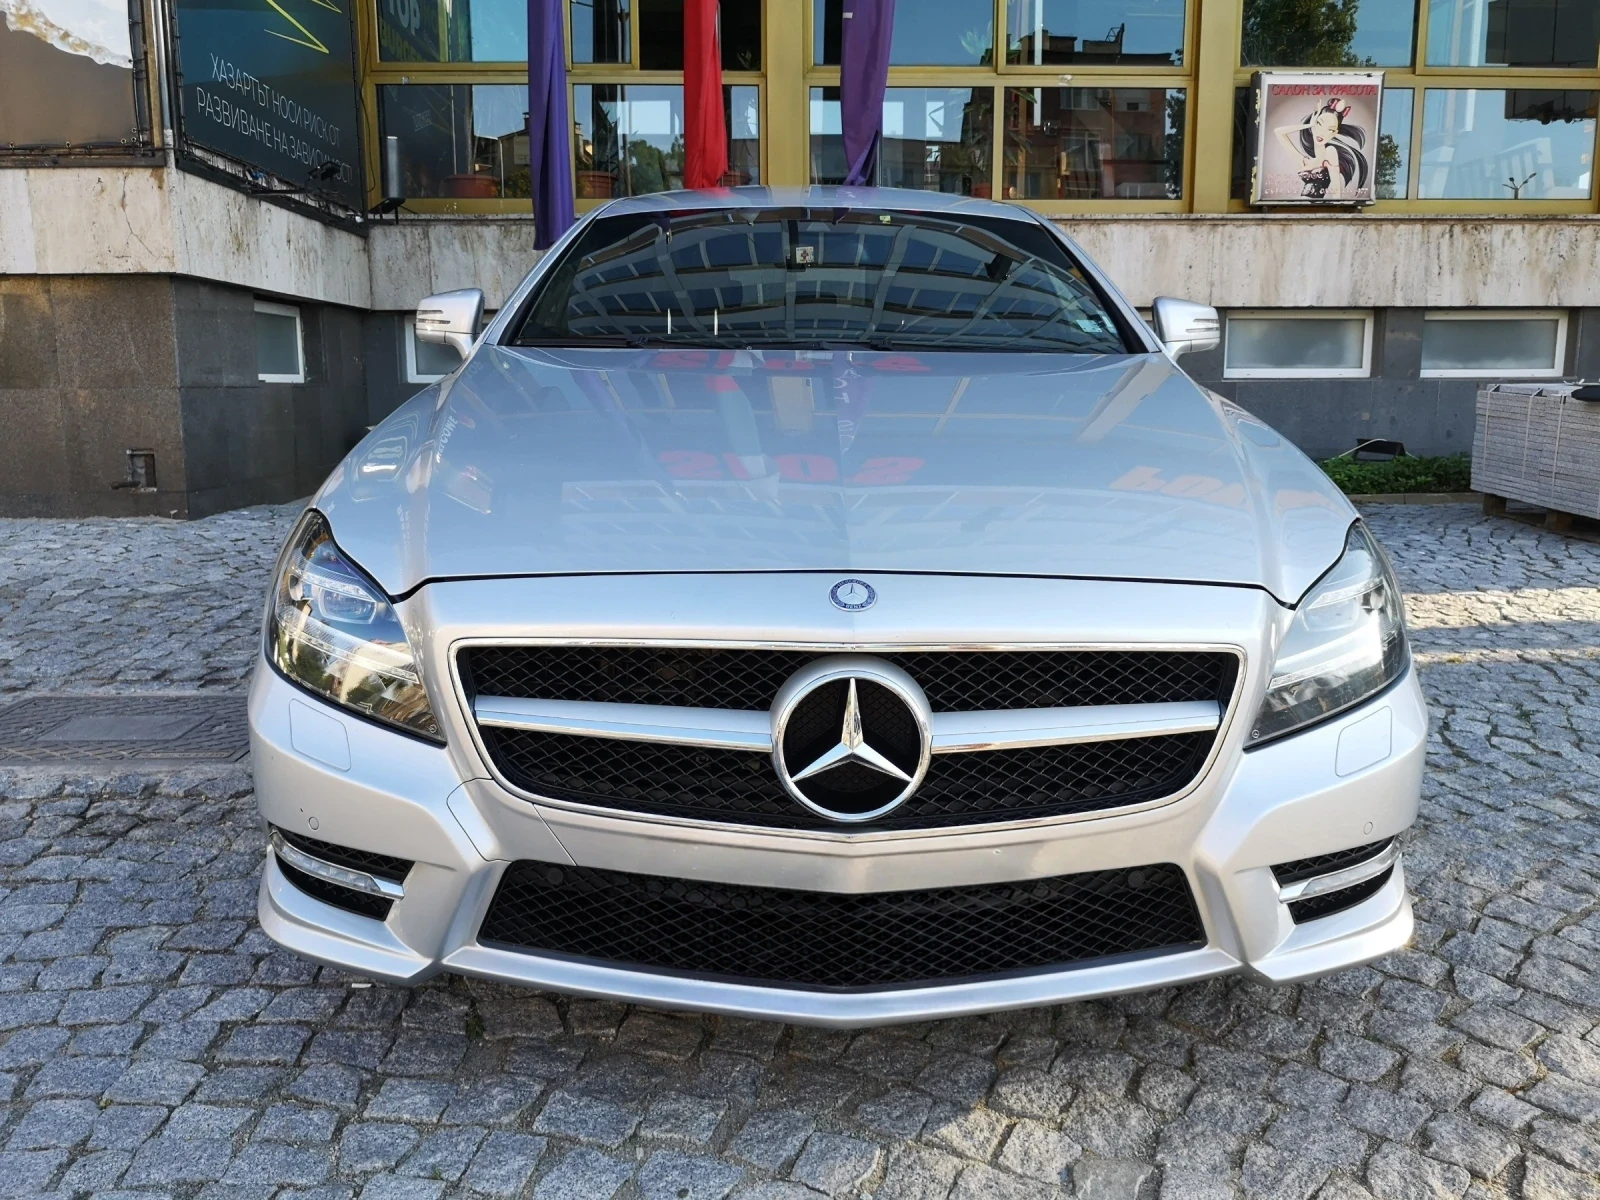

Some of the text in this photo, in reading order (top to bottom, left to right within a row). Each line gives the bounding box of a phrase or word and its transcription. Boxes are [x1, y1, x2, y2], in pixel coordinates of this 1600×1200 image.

[196, 86, 272, 147] РАЗВИВАНЕ
[273, 127, 290, 156] НА
[210, 52, 341, 148] ХАЗАРТЪТ НОСИ РИСК ОТ
[1272, 84, 1377, 96] САЛОН ЗА КРАСОТА
